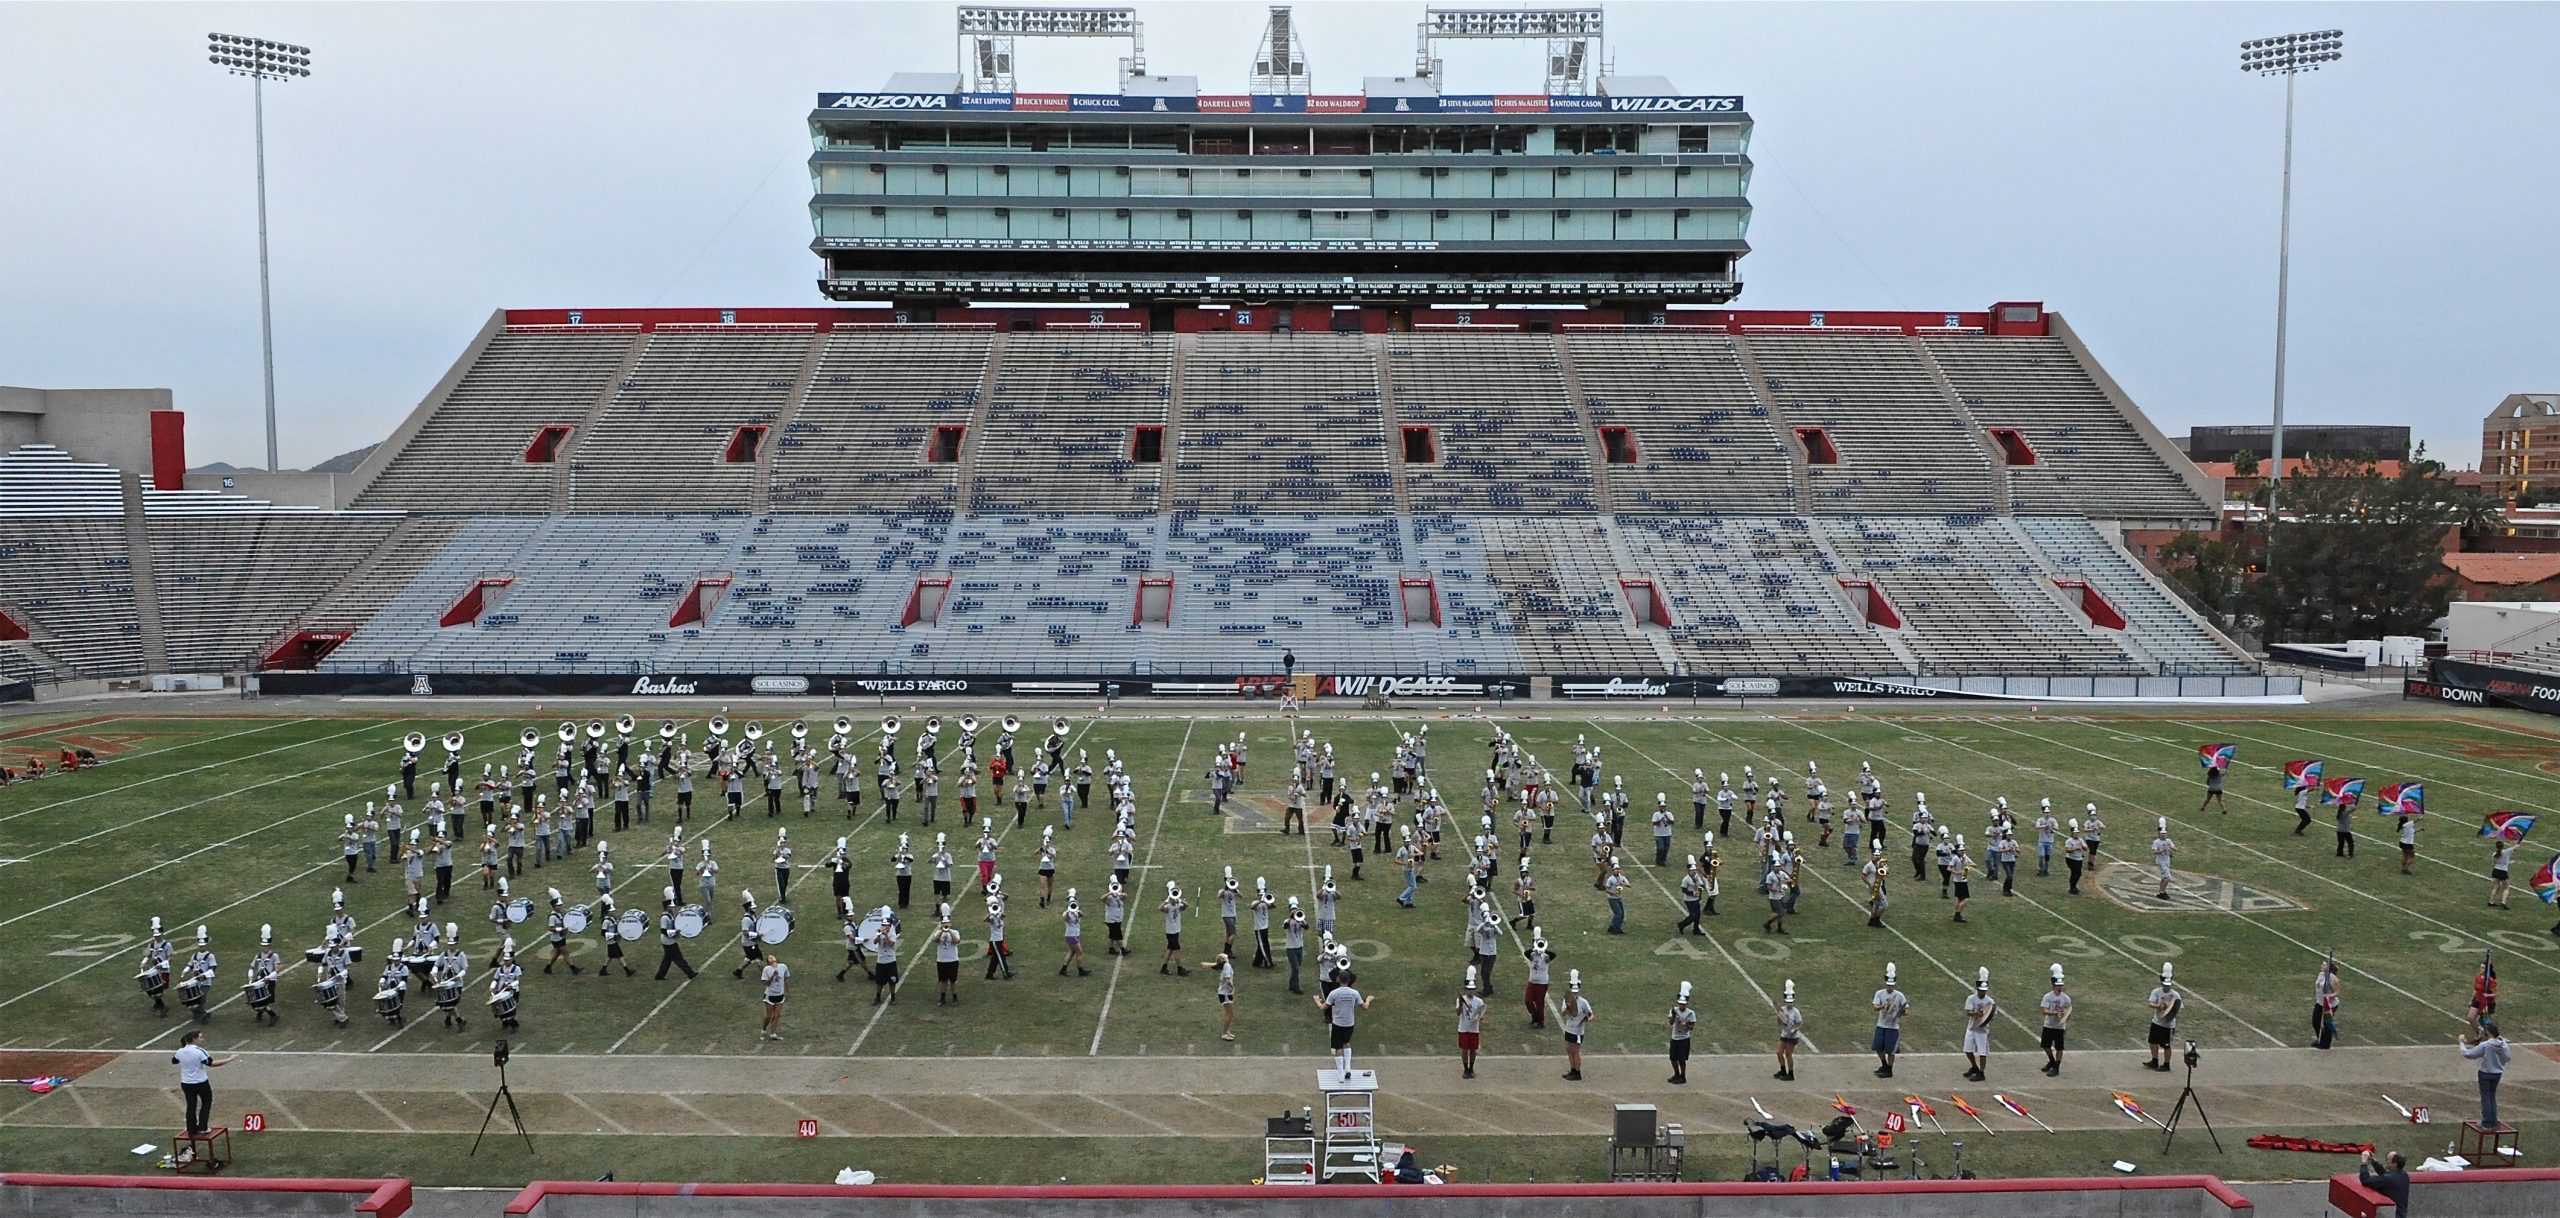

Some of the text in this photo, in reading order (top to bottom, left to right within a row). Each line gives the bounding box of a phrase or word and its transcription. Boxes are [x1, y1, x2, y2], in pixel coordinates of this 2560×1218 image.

[831, 95, 947, 109] ARIZONA
[970, 97, 983, 105] ART
[984, 97, 1011, 105] LUPPINO
[1024, 98, 1042, 106] RICKY
[1044, 98, 1068, 106] HUNLEY
[1079, 98, 1100, 106] CHUCK
[1101, 98, 1120, 106] CECIL
[1500, 99, 1517, 107] CHRIS
[1518, 99, 1548, 107] McALISTER
[1554, 99, 1580, 107] ANTOINE
[1581, 100, 1602, 108] CASON
[1610, 98, 1736, 111] WILDCATS
[570, 316, 581, 325] 17
[722, 315, 734, 324] 18
[896, 315, 907, 324] 19
[1090, 315, 1104, 324] 20
[1238, 315, 1249, 324] 21
[1458, 316, 1471, 325] 22
[1653, 316, 1665, 325] 23
[1811, 318, 1823, 326] 24
[1945, 319, 1959, 327] 25
[223, 479, 233, 487] 16
[632, 677, 698, 695] Bashas'
[864, 680, 967, 691] WELLS FARGO
[1833, 682, 1884, 693] WELLS
[2487, 680, 2533, 695] ARIZONA
[2410, 683, 2483, 703] BEAR DOWN
[2415, 1107, 2429, 1123] 30
[245, 1115, 260, 1130] 30
[1339, 1113, 1355, 1127] 50
[1887, 1113, 1903, 1131] 40
[800, 1121, 816, 1136] 40
